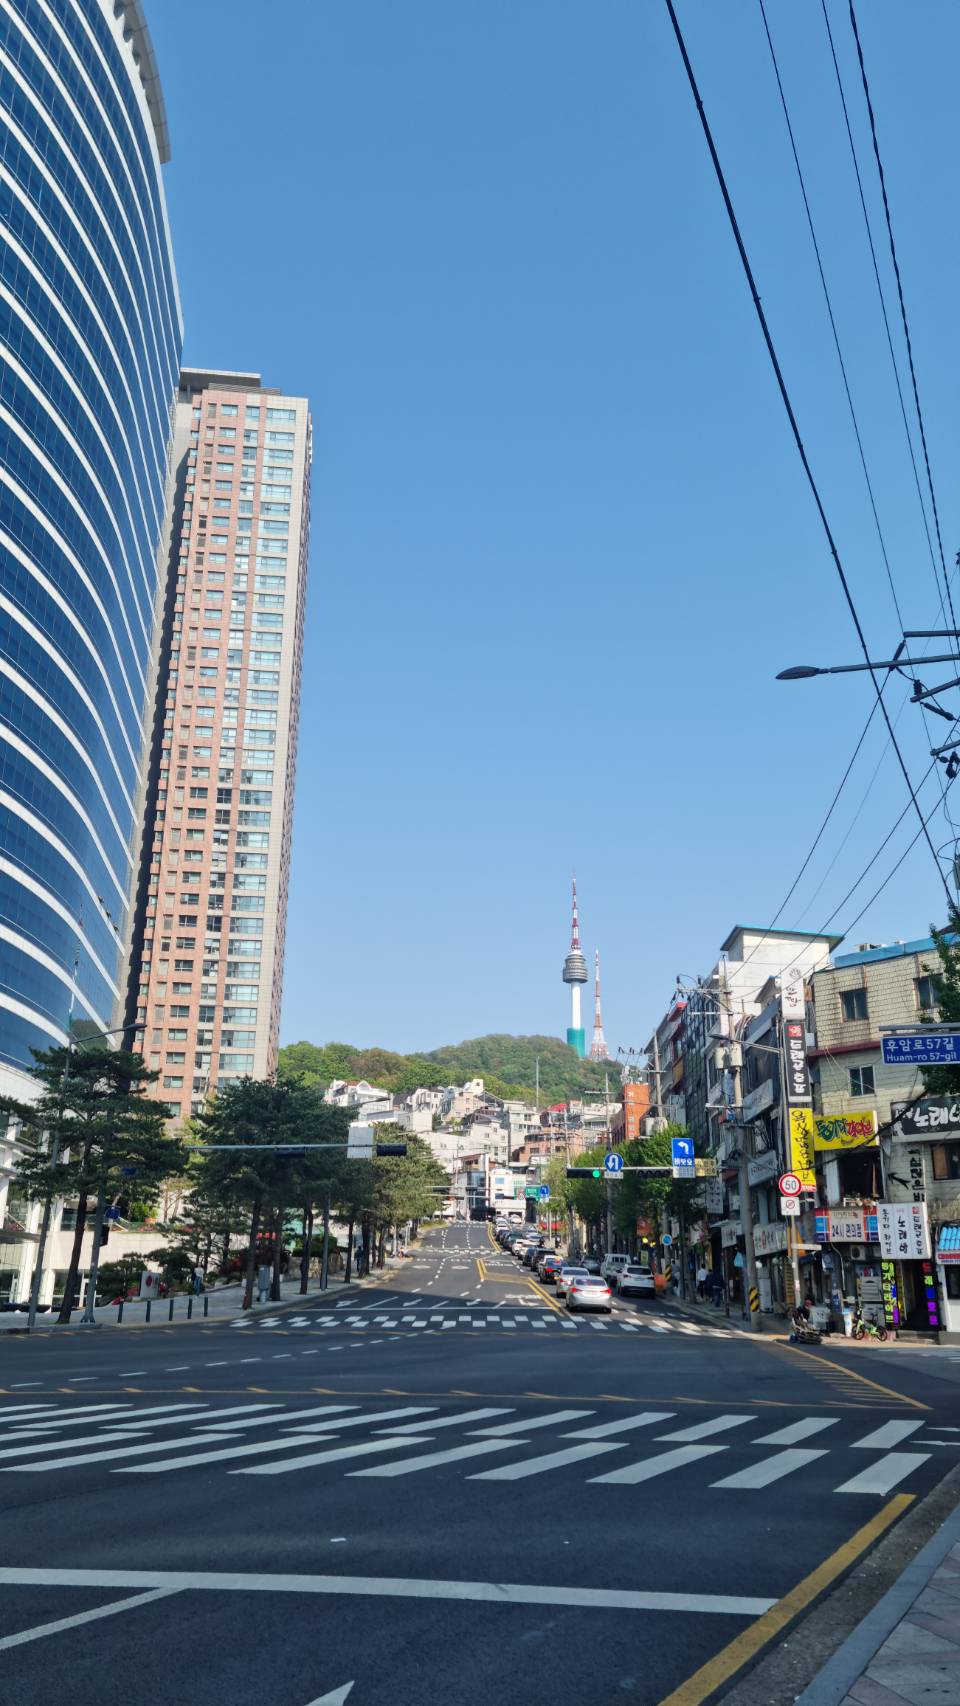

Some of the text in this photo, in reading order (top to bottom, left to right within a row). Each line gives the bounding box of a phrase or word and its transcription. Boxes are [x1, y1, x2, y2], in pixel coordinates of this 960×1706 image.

[886, 1037, 954, 1052] 후암로57길
[886, 1051, 957, 1062] Huam-ro 57-gil
[674, 1157, 693, 1166] 비보호
[785, 1180, 797, 1191] 50
